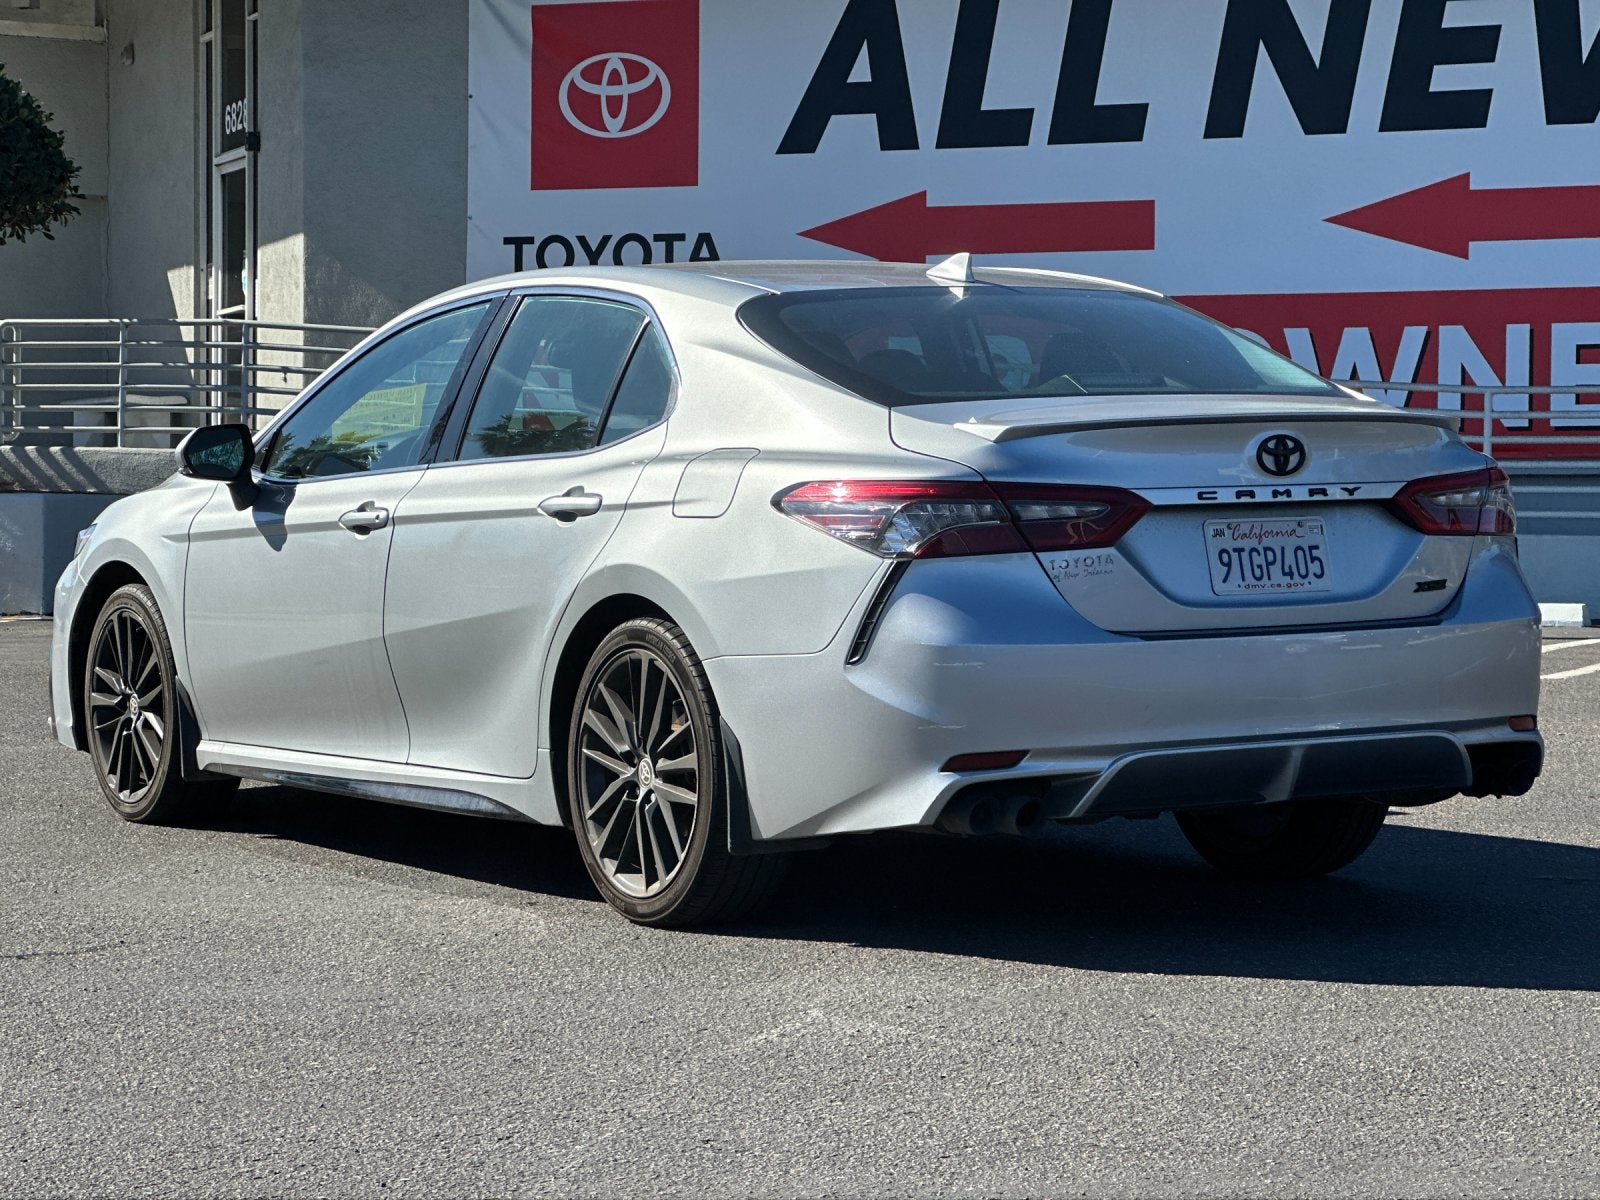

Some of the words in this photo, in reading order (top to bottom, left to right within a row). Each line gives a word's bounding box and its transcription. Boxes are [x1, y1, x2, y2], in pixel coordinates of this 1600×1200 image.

[775, 0, 1149, 154] ALL
[225, 97, 248, 135] 6828
[503, 232, 720, 272] TOYOTA
[1233, 321, 1600, 431] WNE
[1197, 485, 1363, 502] CAMRY
[1211, 528, 1226, 538] JAN
[1231, 523, 1305, 545] California
[1049, 554, 1114, 571] TOYOTA
[1218, 545, 1325, 584] 9TGP405
[1244, 582, 1306, 591] dmv.ca.gov
